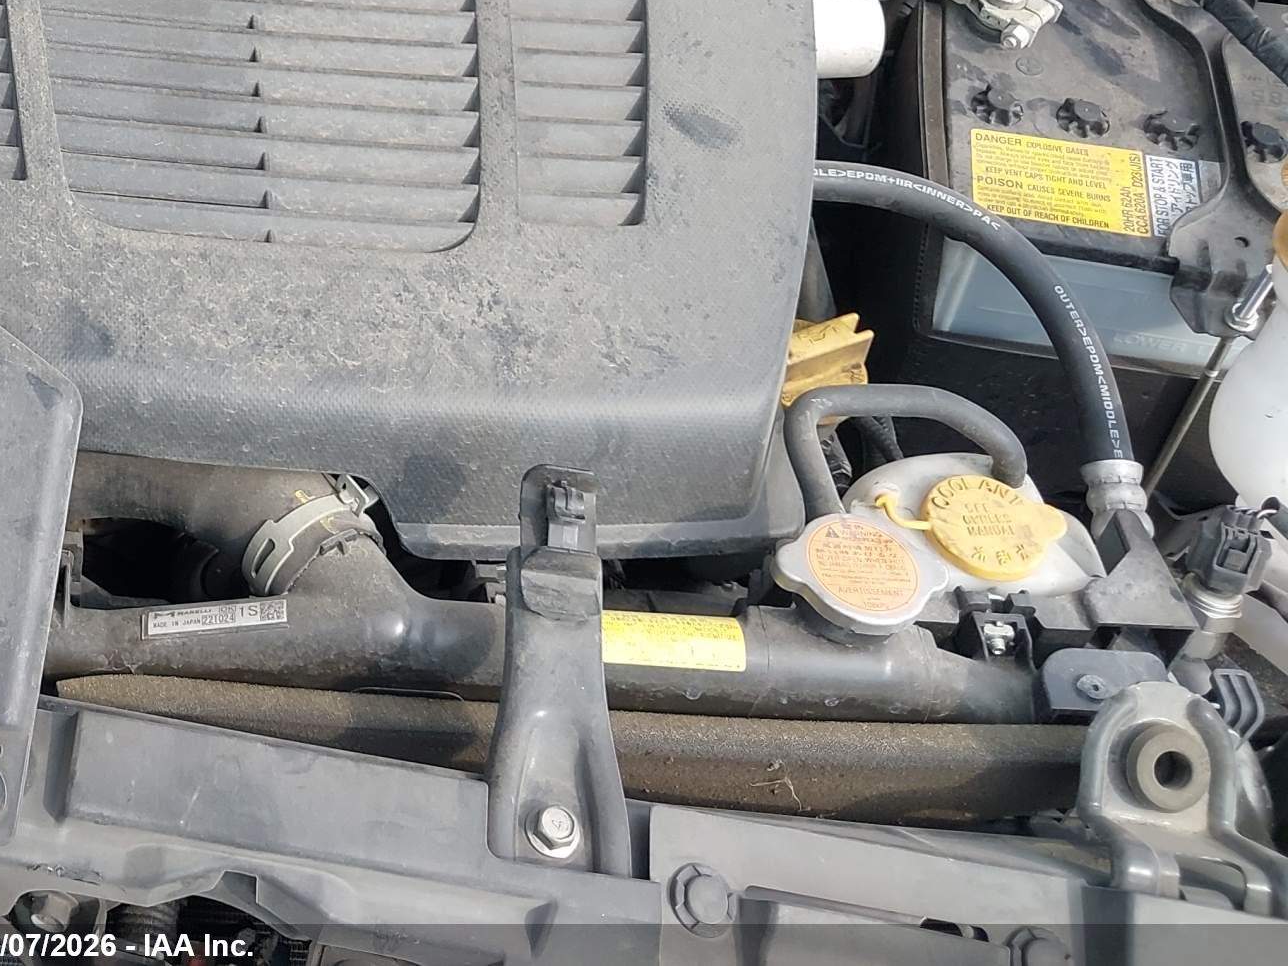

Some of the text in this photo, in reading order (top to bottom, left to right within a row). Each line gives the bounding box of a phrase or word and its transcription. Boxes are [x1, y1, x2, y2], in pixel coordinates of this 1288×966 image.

[975, 132, 1022, 147] DANGER
[1026, 141, 1063, 154] EXPLOSIVE
[985, 165, 1003, 175] KEEP
[1004, 168, 1024, 179] VENT
[1024, 171, 1044, 182] CAPS
[1045, 174, 1066, 184] TIGHT
[1068, 177, 1084, 187] AND
[1085, 179, 1107, 190] LEVEL
[1149, 157, 1165, 186] START
[976, 175, 1023, 189] POISON
[1027, 184, 1055, 195] CAUSES
[1058, 187, 1085, 199] SEVERE
[1086, 191, 1111, 202] BURNS
[1133, 193, 1146, 212] 620A
[1154, 193, 1169, 217] STOP
[986, 204, 1005, 215] KEEP
[1006, 206, 1022, 217] OUT
[1023, 208, 1033, 218] OF
[1034, 209, 1059, 221] REACH
[1061, 213, 1071, 222] OF
[1072, 215, 1110, 228] CHILDREN
[1122, 208, 1135, 232] 20HR
[1135, 212, 1149, 234] CCA
[1157, 217, 1170, 236] FOR
[931, 477, 1023, 510] COOLANT
[967, 525, 1016, 536] MANUAL
